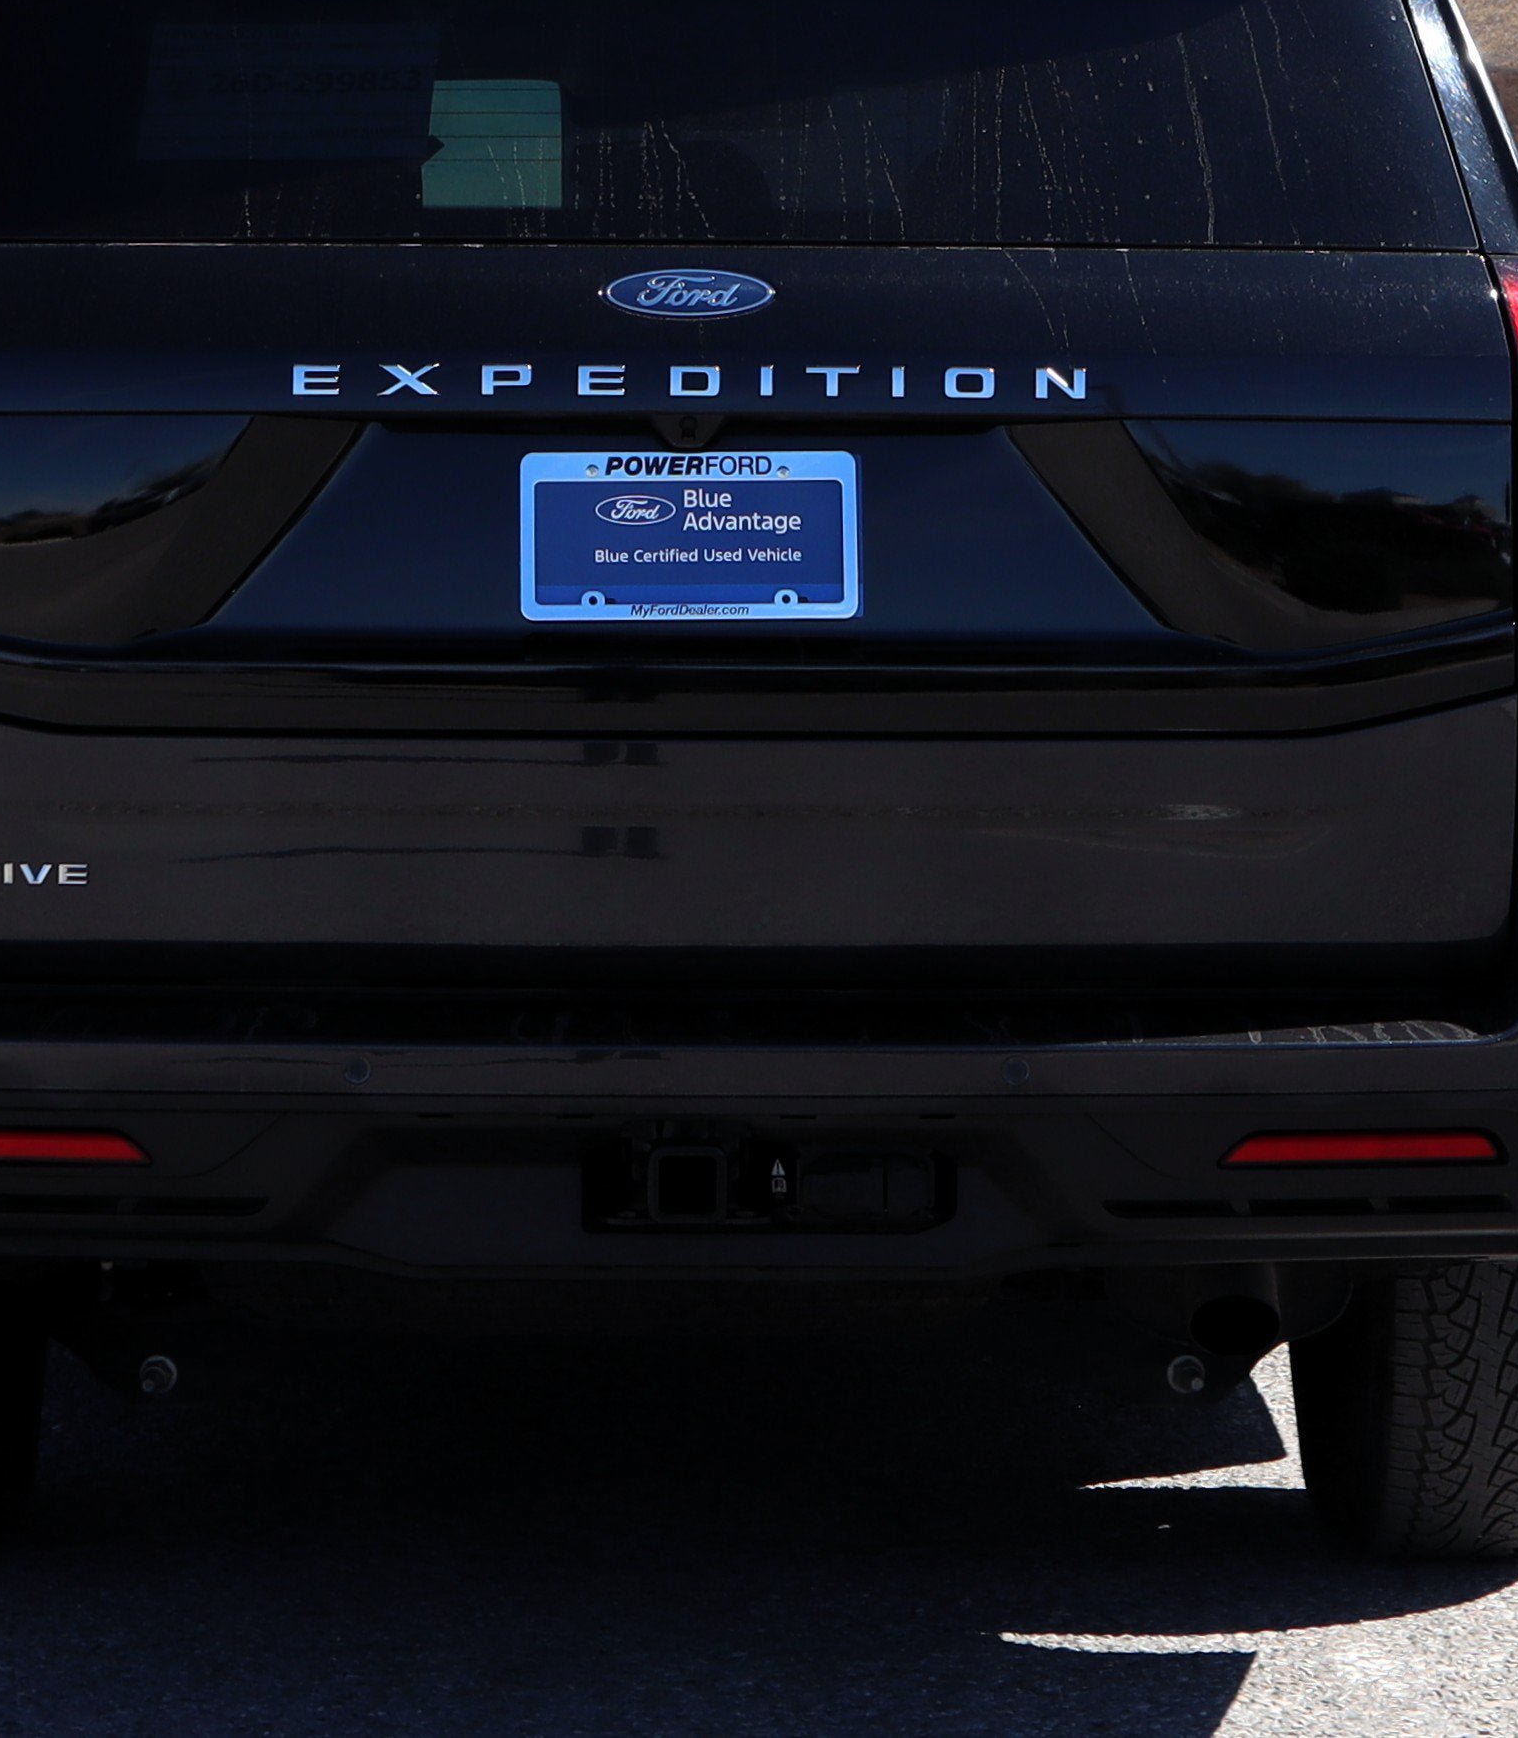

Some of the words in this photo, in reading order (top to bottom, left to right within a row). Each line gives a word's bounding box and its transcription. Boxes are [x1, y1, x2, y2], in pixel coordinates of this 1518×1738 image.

[637, 274, 741, 307] Ford
[292, 362, 1087, 400] EXPEDITION
[610, 498, 660, 521] Ford
[683, 488, 733, 508] Blue
[683, 511, 802, 534] Advantage
[594, 549, 629, 563] Blue
[633, 548, 699, 563] Certified
[703, 548, 743, 562] Used
[747, 547, 802, 562] Vehicle
[630, 603, 750, 619] MyFordDealer.com
